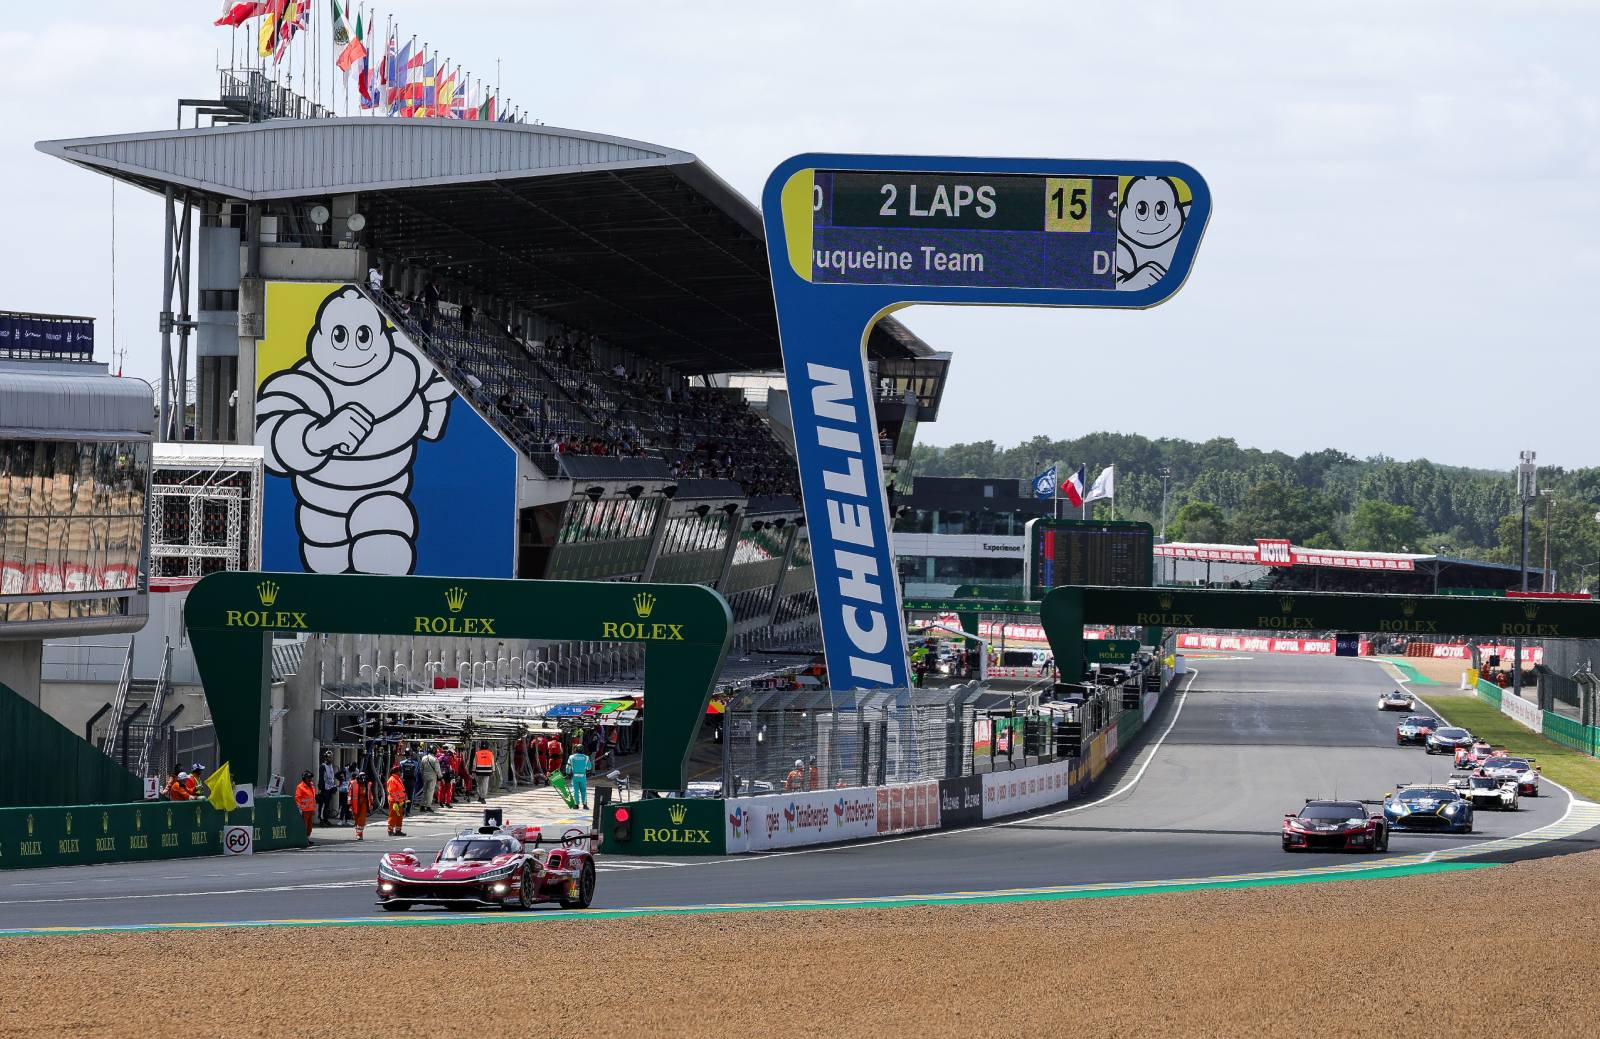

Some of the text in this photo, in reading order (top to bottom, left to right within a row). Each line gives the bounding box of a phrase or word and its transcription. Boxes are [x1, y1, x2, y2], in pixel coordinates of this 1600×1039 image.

[880, 184, 897, 216] 2
[908, 185, 997, 218] LAPS
[1051, 187, 1088, 220] 15
[813, 245, 984, 274] uqueine Team
[983, 543, 1021, 552] Experience
[1260, 543, 1290, 562] MOTUL
[226, 609, 685, 641] ROLEX ROLEX ROLEX
[1136, 612, 1560, 636] ROLEX ROLEX ROLEX ROLEX
[1274, 640, 1299, 651] MOTUL
[1303, 641, 1330, 652] MOTUL
[1433, 646, 1464, 657] MOTUL
[229, 834, 247, 847] 60
[643, 828, 711, 843] ROLEX
[20, 841, 42, 856] ROLEX
[59, 839, 80, 854] ROLEX
[96, 837, 115, 851] ROLEX
[130, 835, 148, 849] ROLEX
